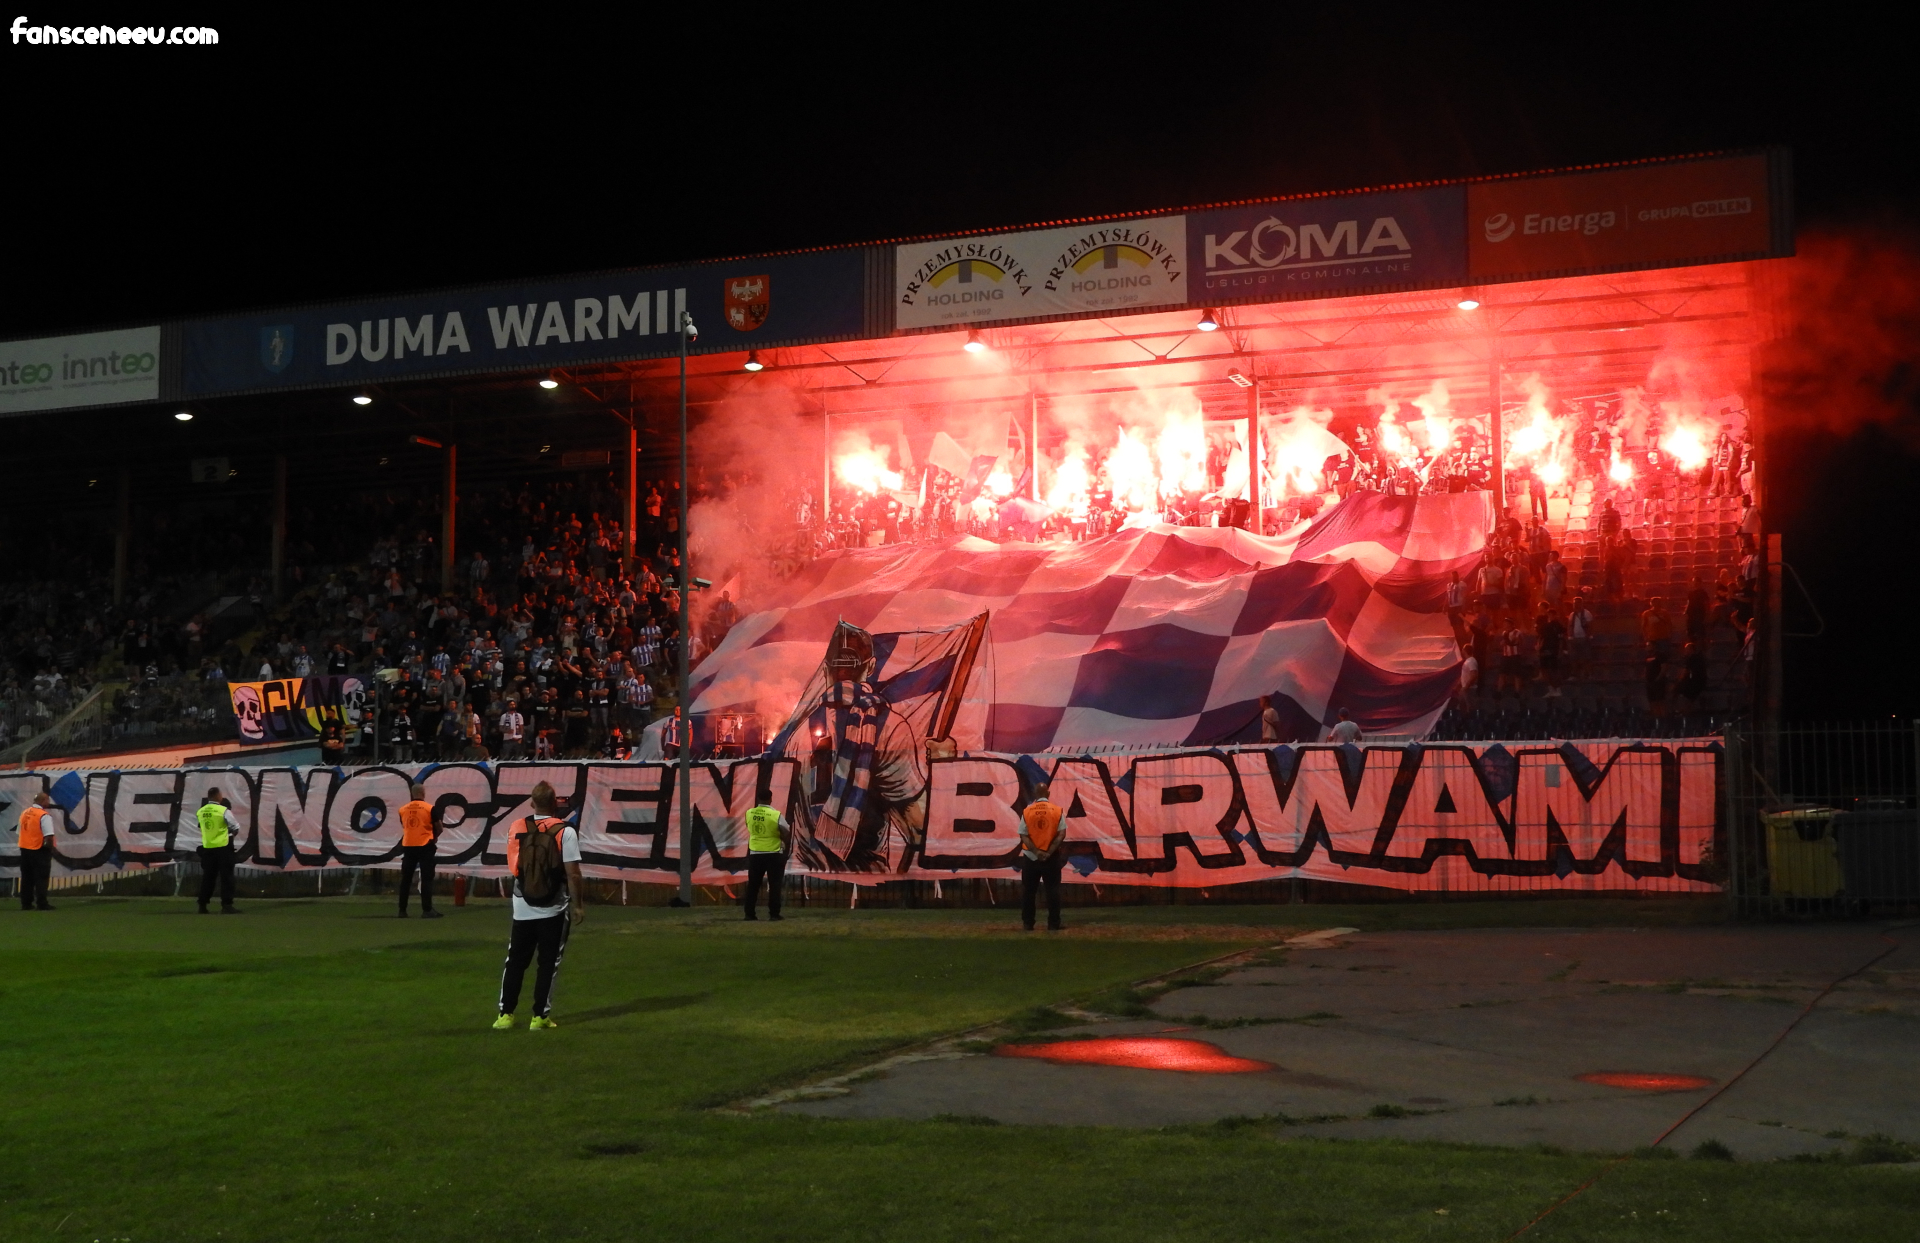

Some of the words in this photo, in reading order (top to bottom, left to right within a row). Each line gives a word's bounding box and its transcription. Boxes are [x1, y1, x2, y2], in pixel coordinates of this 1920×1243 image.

[1523, 210, 1616, 235] Energa
[1638, 206, 1690, 222] GRUPA
[1695, 200, 1748, 216] ORLEN
[1044, 228, 1182, 293] PRZEMYSŁÓWKA
[1205, 216, 1412, 268] KOMA
[902, 244, 1033, 306] PRZEMYSŁÓWKA
[1071, 274, 1152, 293] HOLDING
[1206, 274, 1276, 289] USŁUGI
[1287, 263, 1412, 281] KOMUNALNE
[927, 289, 1004, 307] HOLDING
[326, 311, 471, 366] DUMA
[487, 288, 687, 350] WARMII
[919, 744, 1724, 882] BARWAMI
